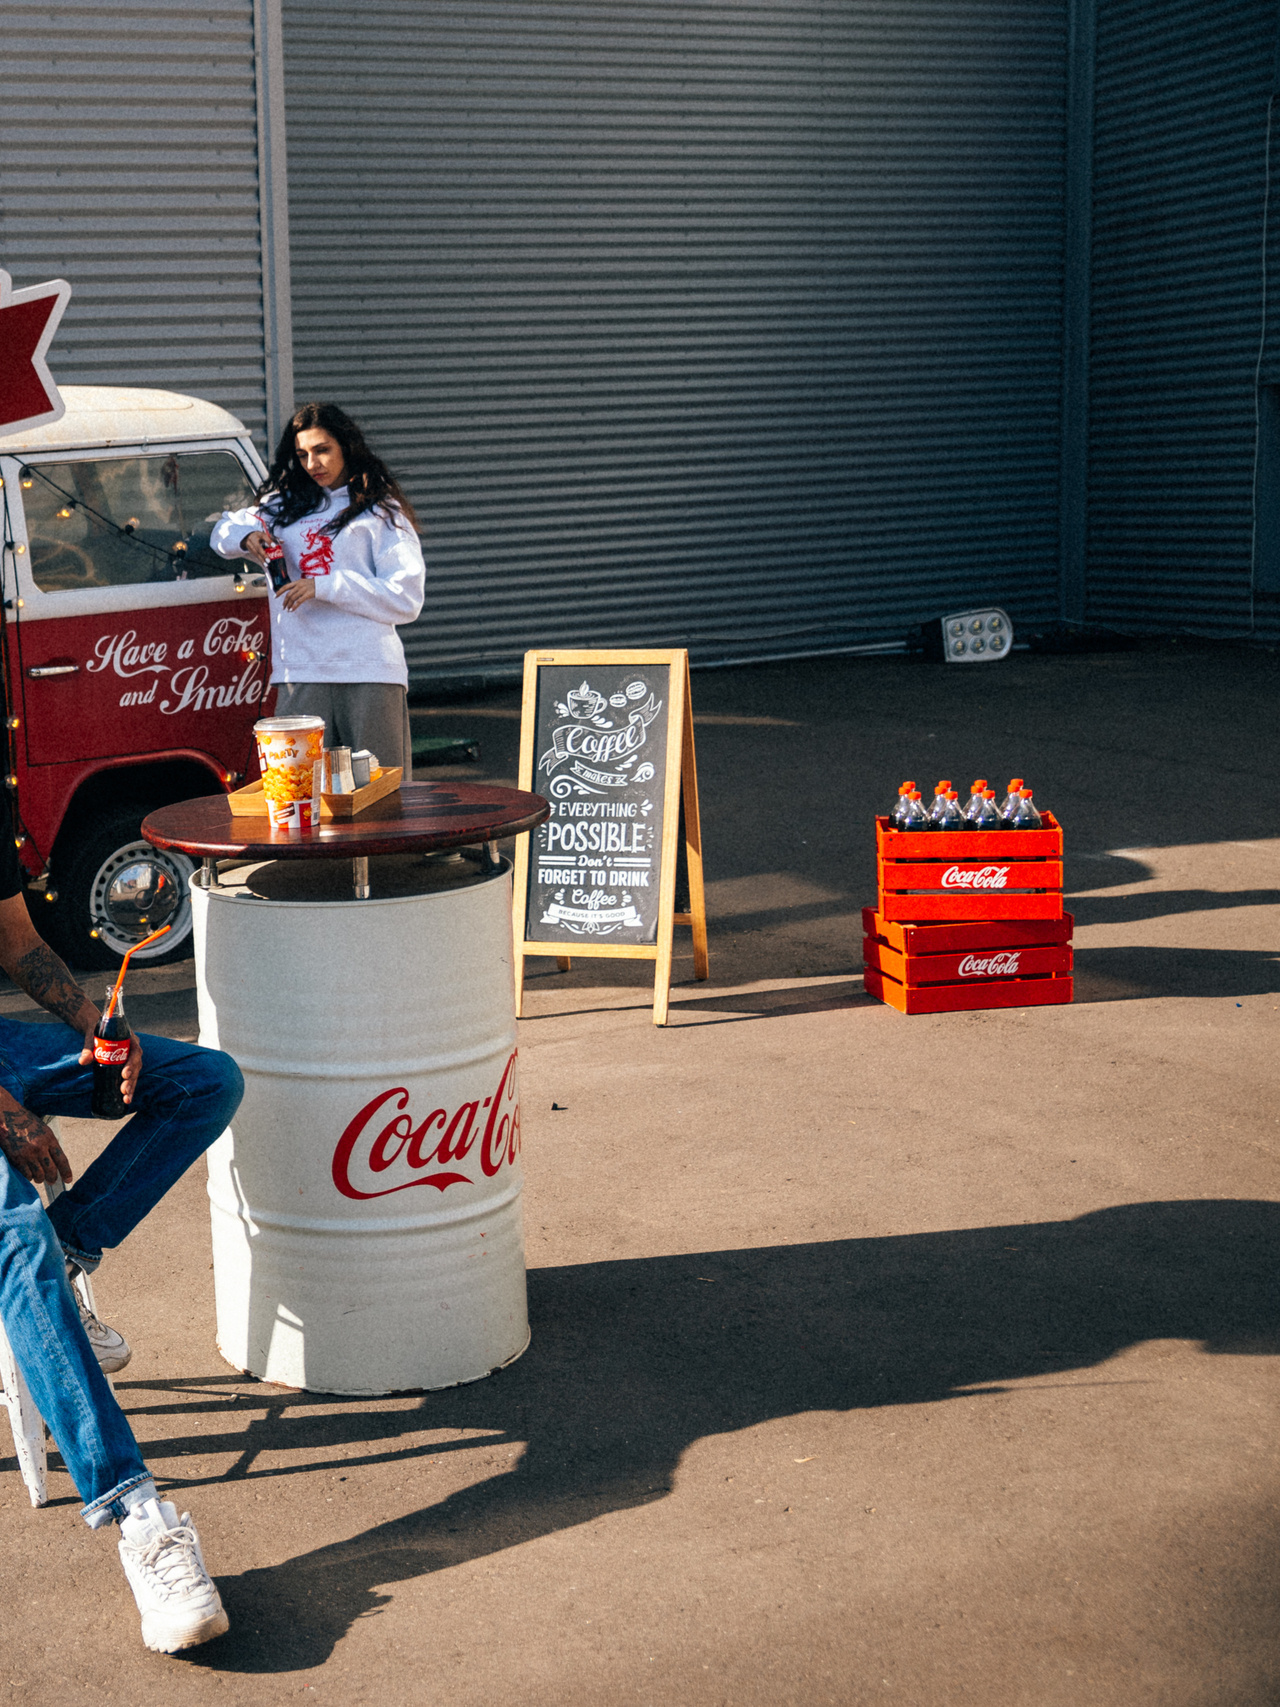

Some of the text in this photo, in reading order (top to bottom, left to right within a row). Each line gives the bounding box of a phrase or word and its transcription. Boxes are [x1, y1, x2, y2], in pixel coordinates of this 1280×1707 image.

[86, 615, 264, 678] Have a Coke
[119, 659, 272, 715] and Smile!
[268, 748, 300, 761] PARTY
[566, 726, 640, 763] Coffee
[582, 769, 613, 785] makes
[558, 801, 638, 818] EVERYTHING
[547, 821, 646, 854] POSSIBLE
[577, 854, 613, 868] Don't
[537, 868, 650, 887] FORGET TO DRINK
[941, 866, 1010, 888] Coca-Cola
[571, 888, 618, 911] Coffee
[558, 909, 589, 919] BECAUSE
[605, 911, 626, 919] GOOD
[958, 952, 1022, 976] Coca-Cola
[95, 1046, 128, 1062] Coca-Cola
